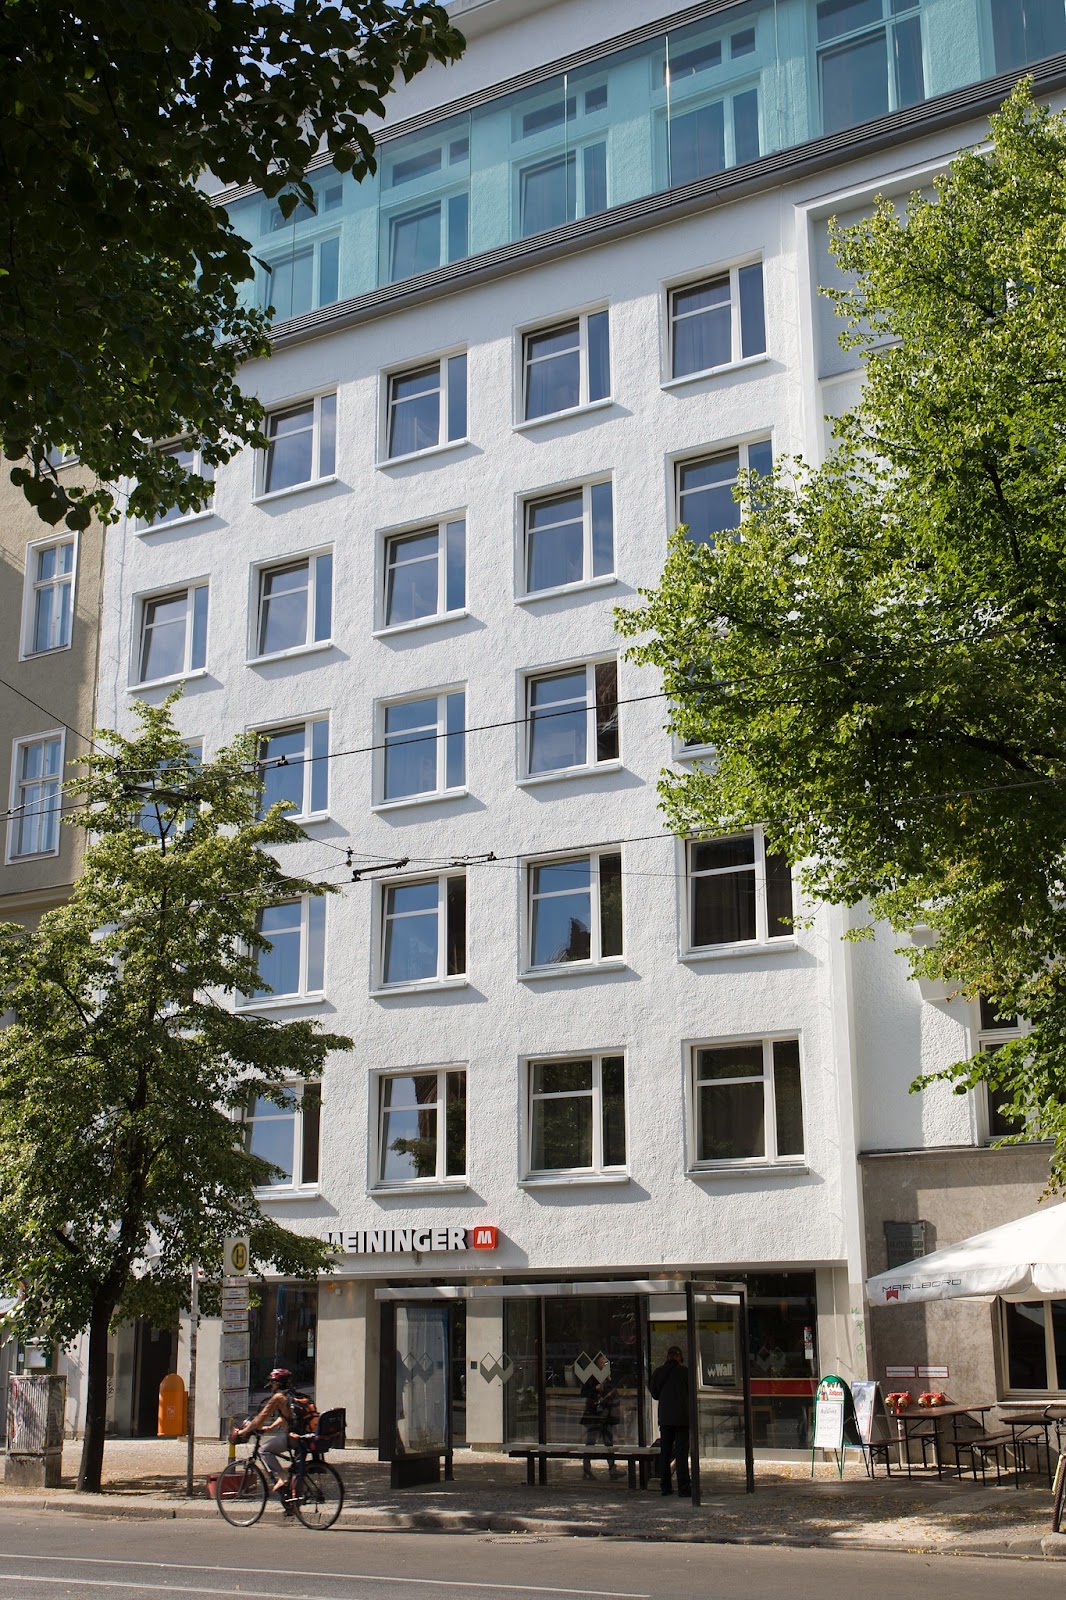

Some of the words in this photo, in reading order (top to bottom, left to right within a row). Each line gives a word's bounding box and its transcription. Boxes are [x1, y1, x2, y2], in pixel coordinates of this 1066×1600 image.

[476, 1230, 492, 1244] M
[882, 1279, 962, 1293] MARLBORO
[715, 1363, 732, 1376] Wall
